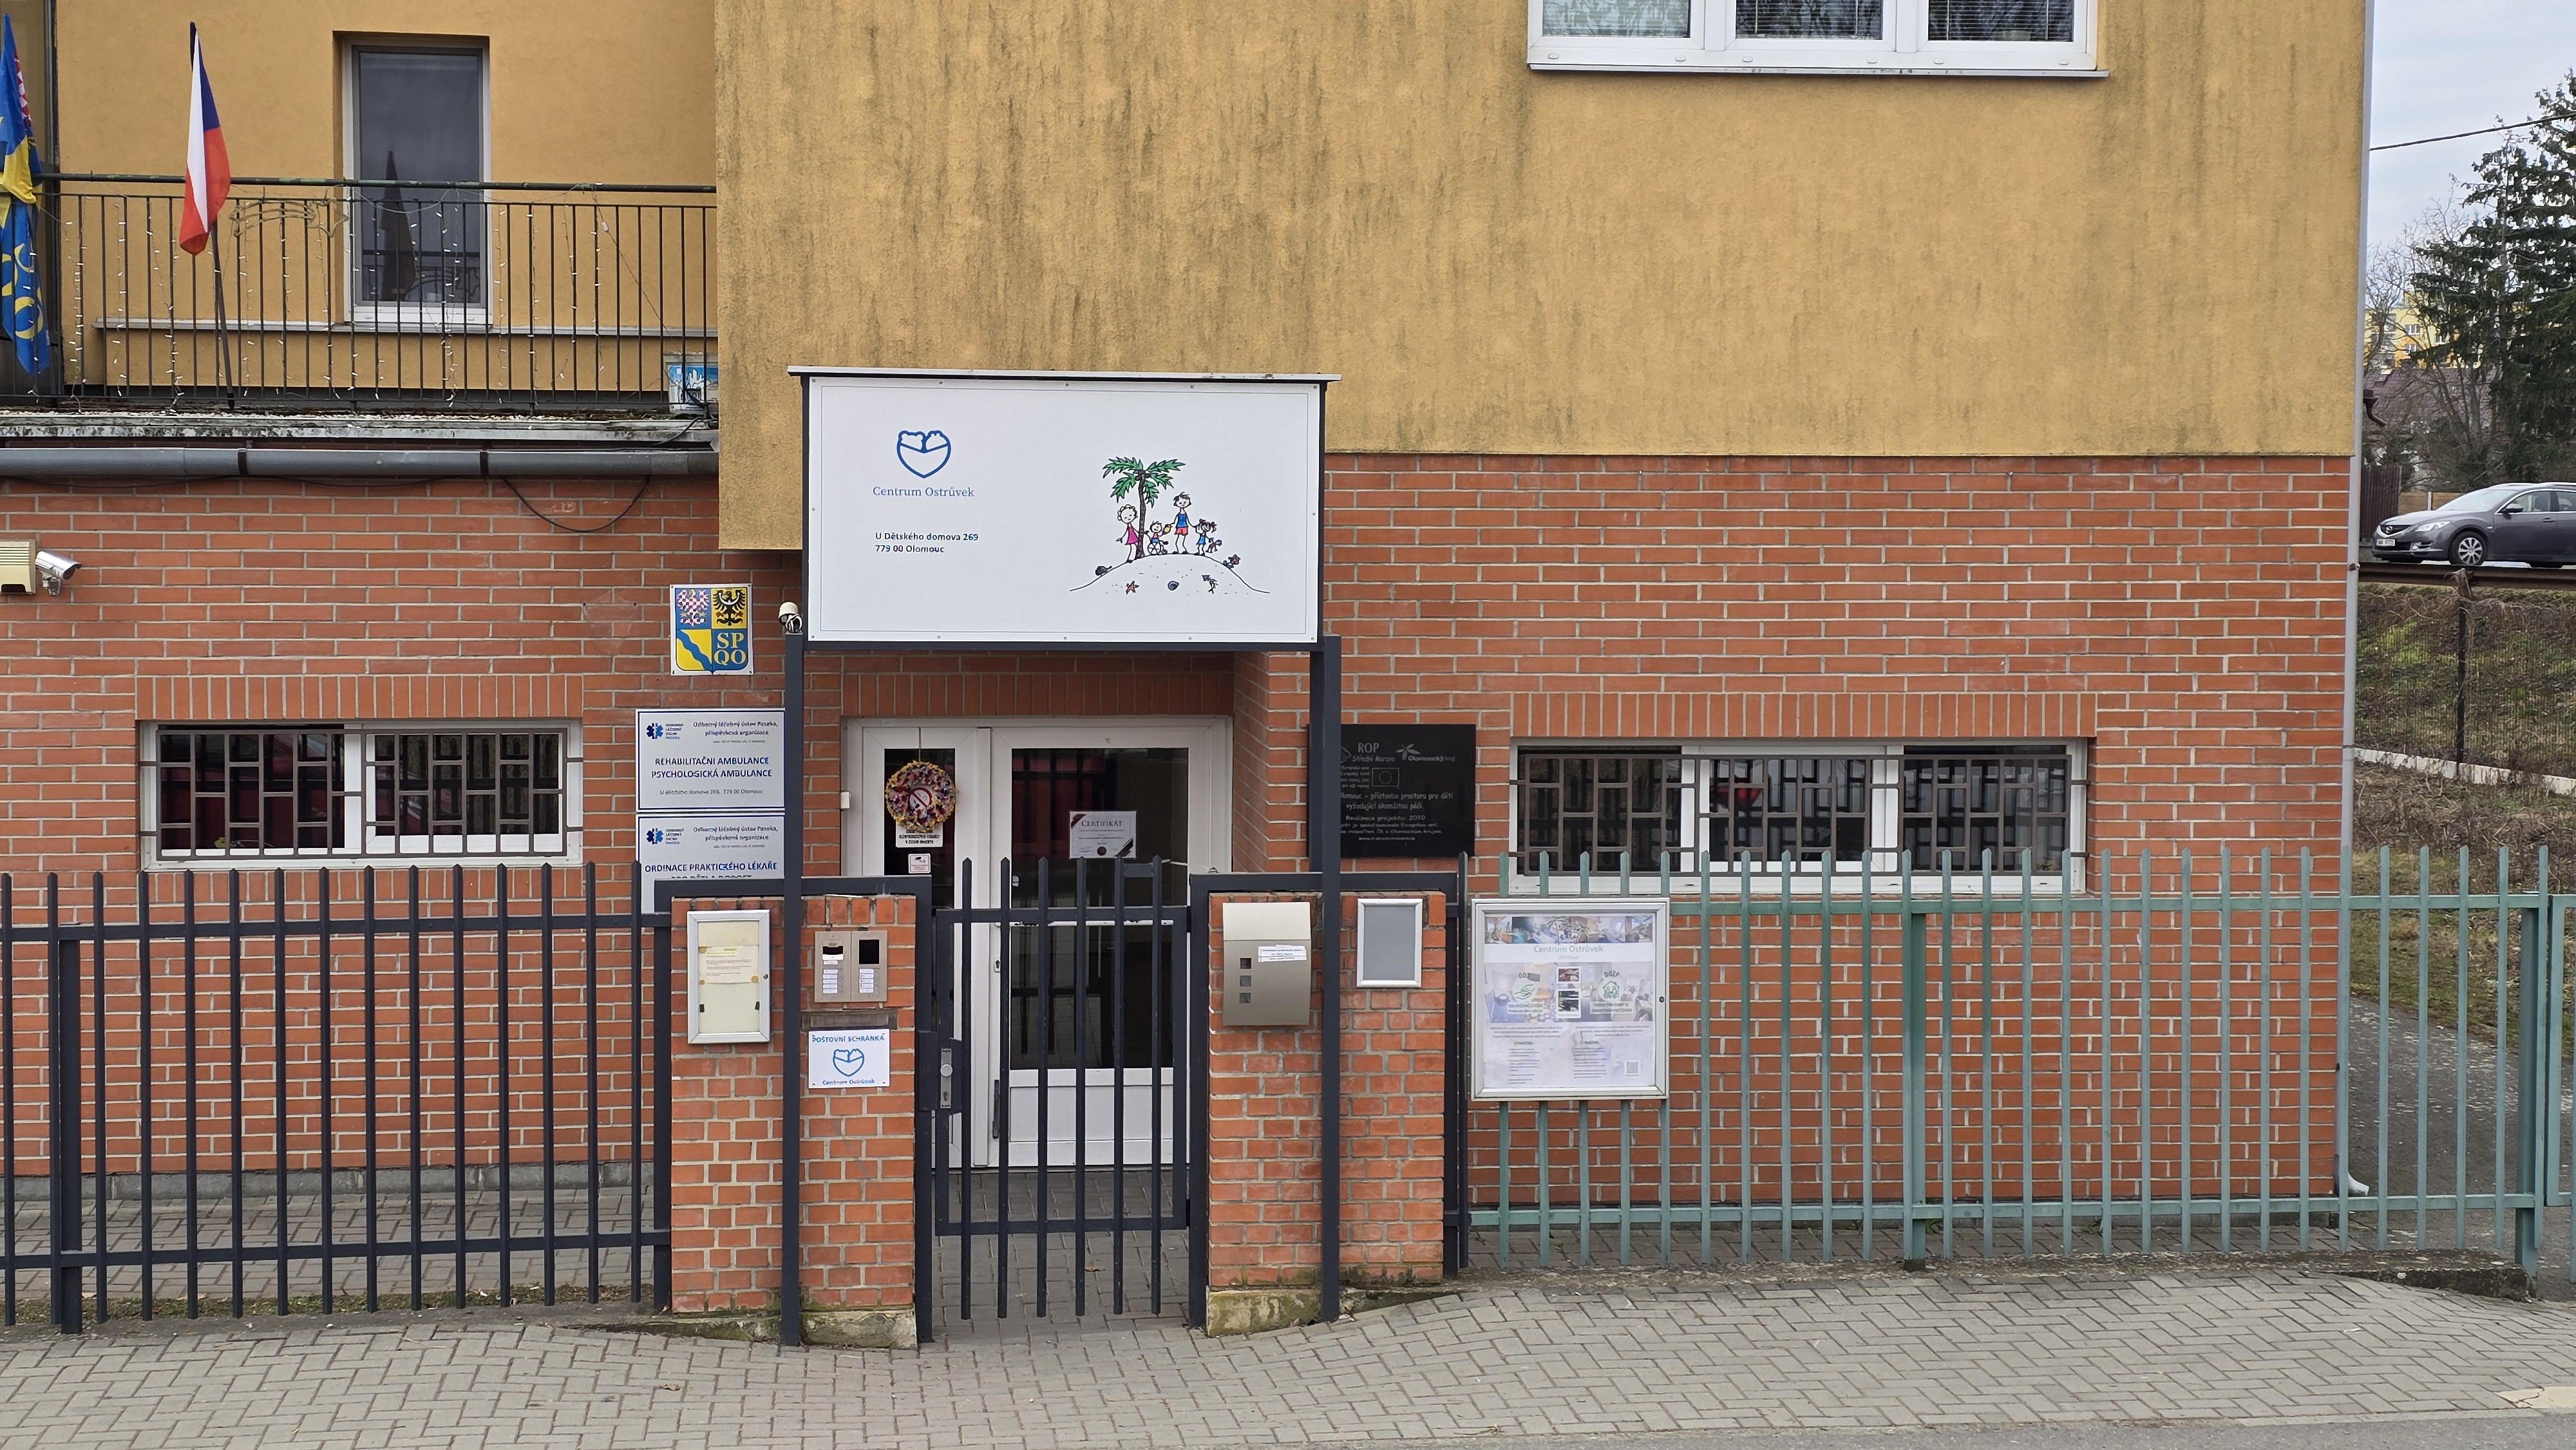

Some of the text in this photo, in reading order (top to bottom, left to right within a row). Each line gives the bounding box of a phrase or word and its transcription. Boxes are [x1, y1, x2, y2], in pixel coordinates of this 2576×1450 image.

[873, 486, 974, 497] Centrum Ostrůvek
[884, 532, 924, 540] Dětského
[926, 532, 961, 541] domova
[905, 545, 944, 553] Olomouc
[717, 632, 744, 648] SP
[714, 649, 746, 666] QO
[1358, 742, 1379, 753] ROP
[717, 757, 770, 766] AMBULANCE
[651, 769, 772, 778] PSYCHOLOGICKÁ AMBULANCE
[1370, 792, 1399, 800] přístavba
[1346, 802, 1376, 811] vyžadující
[645, 863, 687, 872] ORDINACE
[748, 861, 778, 870] LÉKAŘE
[1569, 945, 1604, 953] Ostrůvek
[812, 1035, 846, 1043] POŠTOVNÍ
